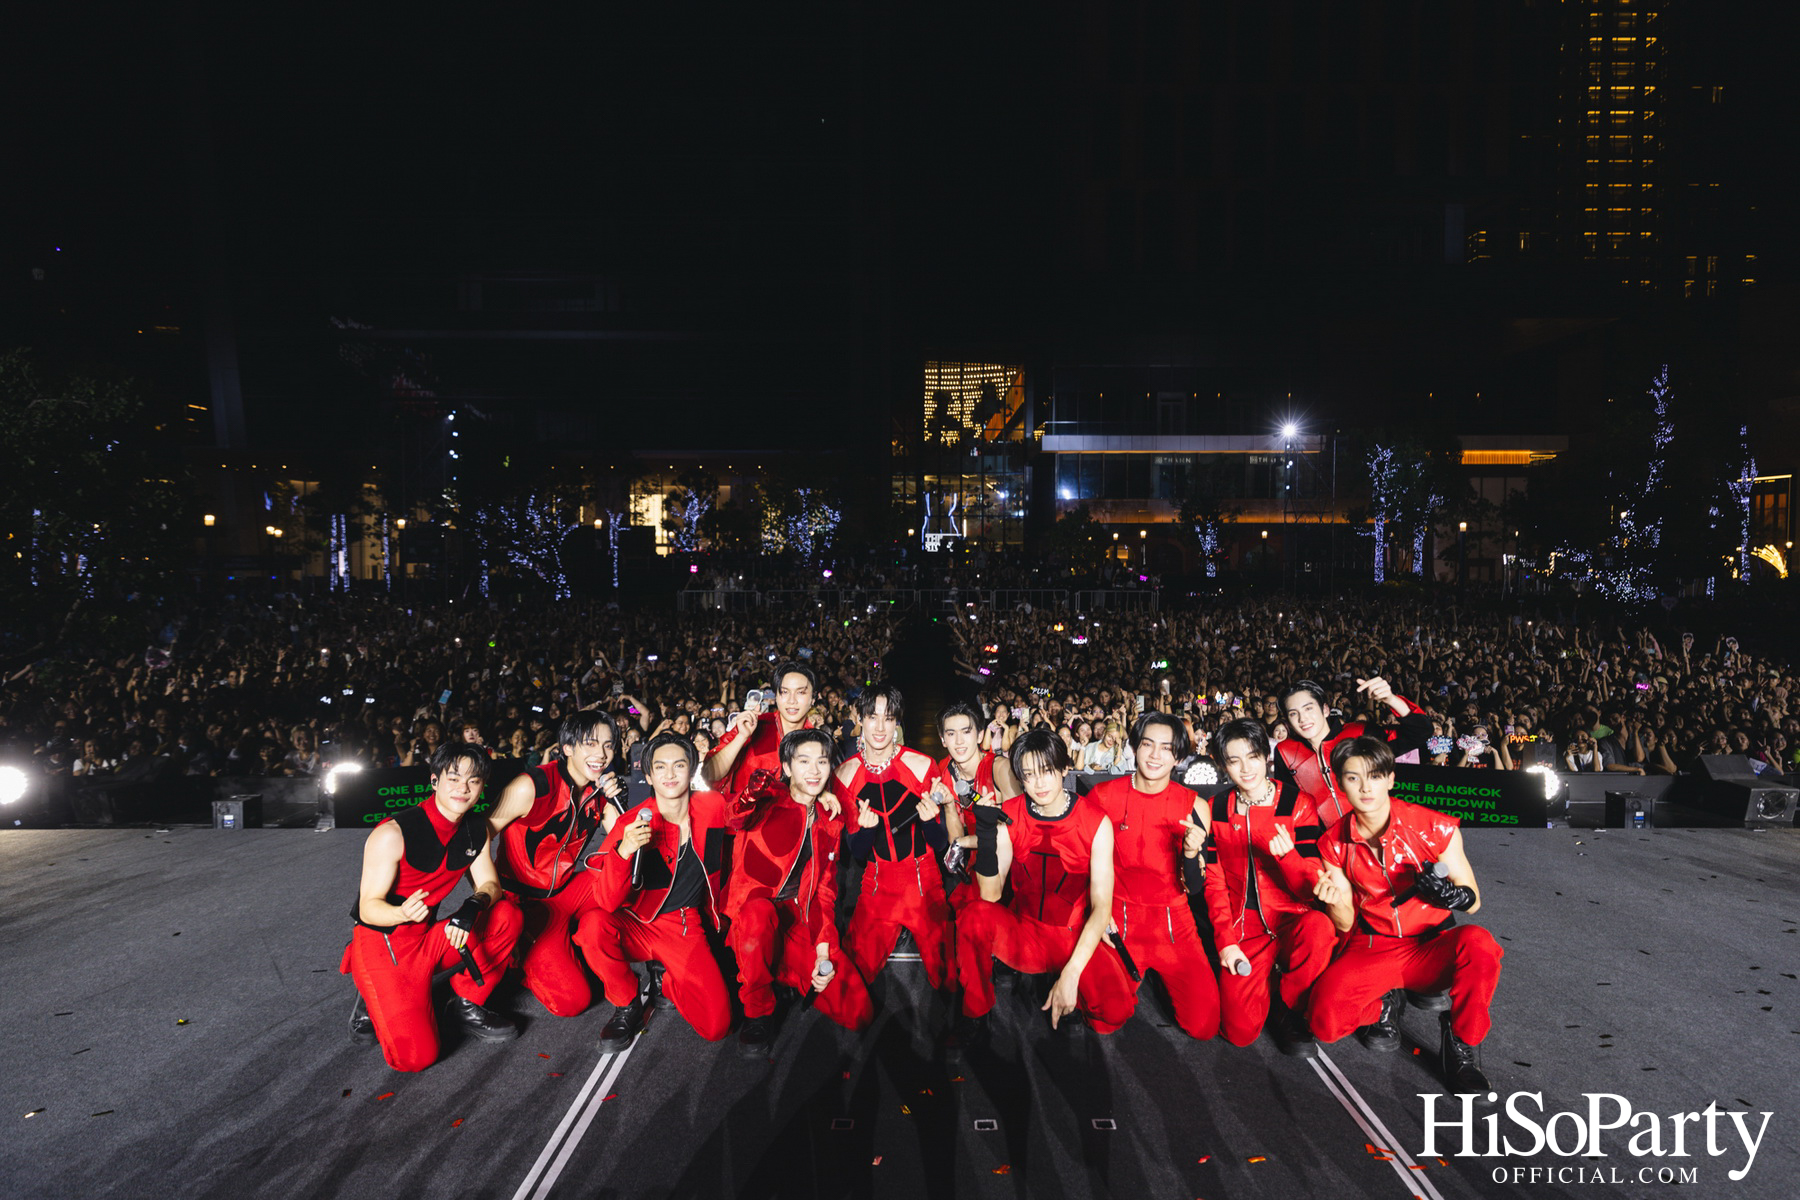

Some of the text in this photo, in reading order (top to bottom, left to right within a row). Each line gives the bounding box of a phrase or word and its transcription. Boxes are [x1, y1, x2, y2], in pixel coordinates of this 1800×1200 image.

[377, 785, 410, 797] ONE
[1392, 781, 1502, 798] ONE BANGKOK
[1480, 812, 1519, 825] 2025
